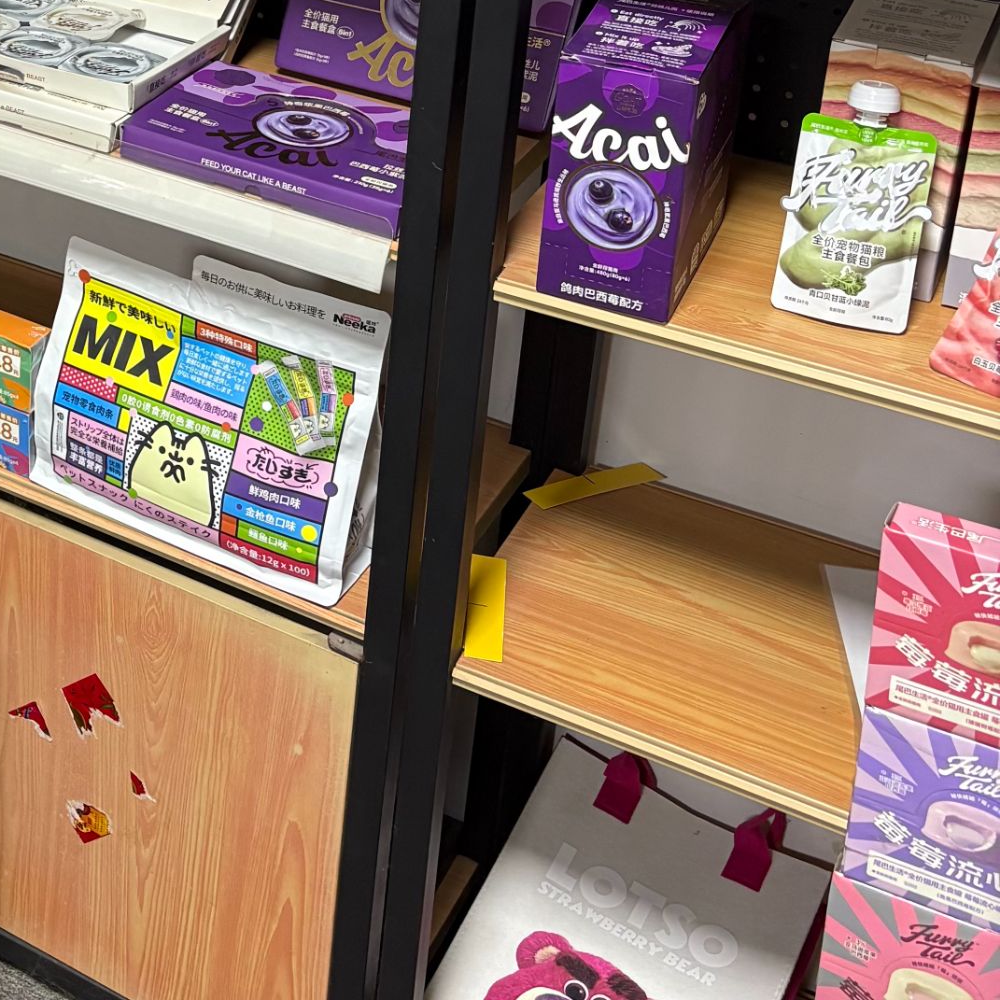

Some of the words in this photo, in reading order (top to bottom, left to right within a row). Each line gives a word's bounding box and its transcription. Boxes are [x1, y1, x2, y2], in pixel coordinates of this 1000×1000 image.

[304, 8, 339, 24] 全价猫用
[553, 104, 690, 171] Acai
[201, 158, 220, 169] FEED
[221, 163, 242, 176] YOUR
[242, 170, 257, 180] CAT
[258, 176, 273, 185] LIKE
[282, 182, 307, 194] BEAST
[812, 234, 885, 258] 全价宠物猫粮
[822, 248, 870, 267] 主食餐包
[561, 282, 643, 311] 鸽肉巴西莓配方
[334, 314, 376, 334] Neeka
[73, 315, 175, 386] MIX
[62, 391, 114, 420] 宠物零食肉条
[249, 484, 301, 510] 鲜鸡肉口味
[246, 507, 296, 532] 金枪鱼口味
[545, 842, 738, 968] LOTSO
[537, 880, 658, 956] STRAWBERRY
[663, 952, 717, 986] BEAR
[900, 923, 975, 951] Furry
[916, 941, 975, 966] Tail
